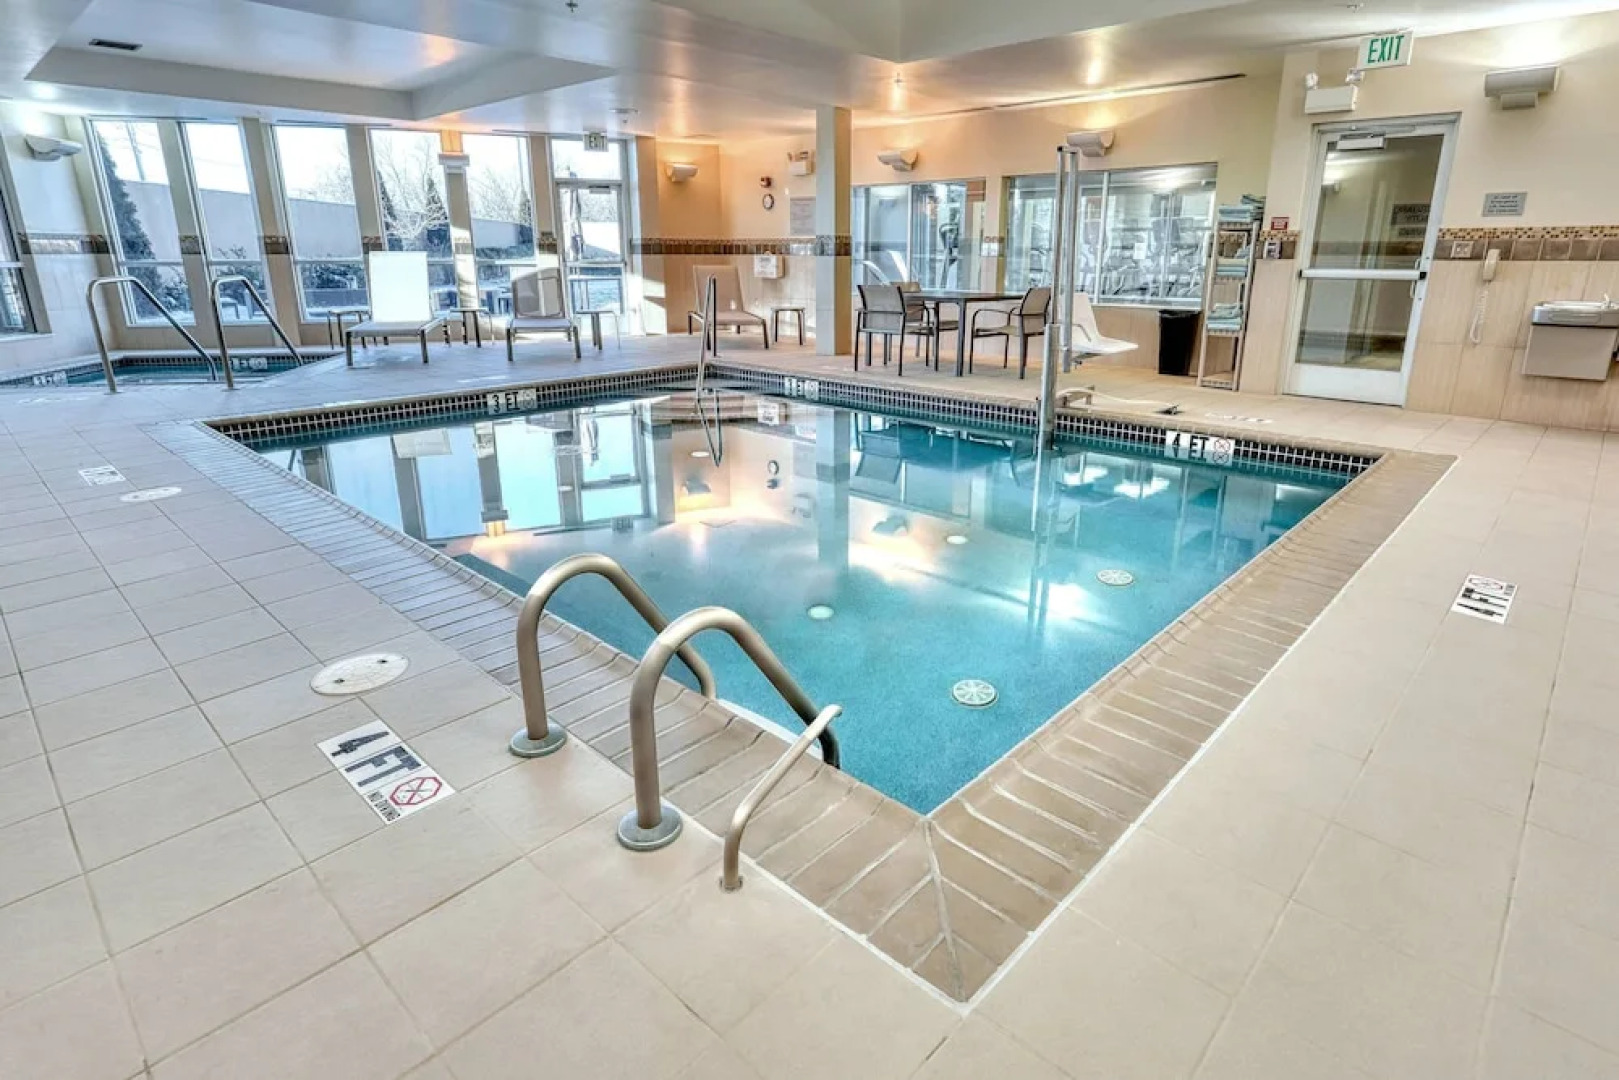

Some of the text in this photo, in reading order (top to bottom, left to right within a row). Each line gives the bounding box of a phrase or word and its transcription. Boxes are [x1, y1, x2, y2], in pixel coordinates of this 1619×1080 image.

[1367, 34, 1405, 63] EXIT
[330, 731, 422, 787] 4 FT
